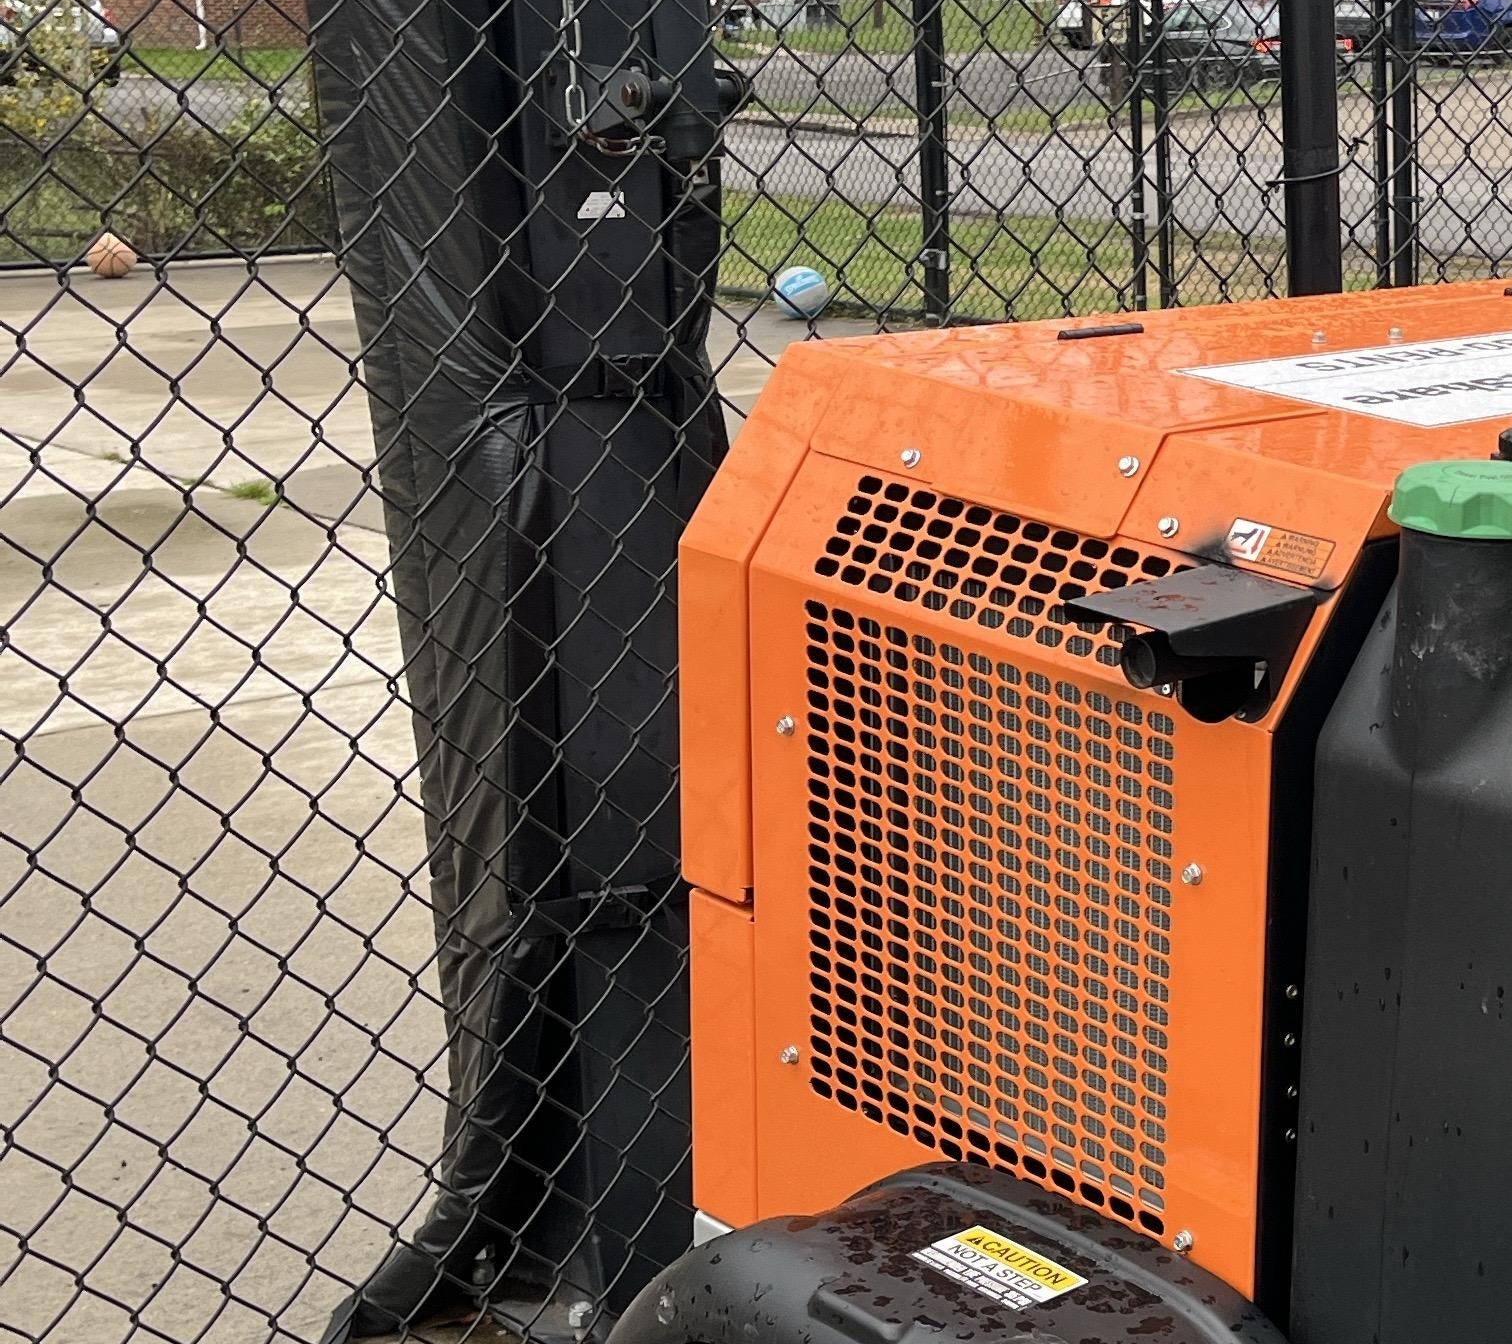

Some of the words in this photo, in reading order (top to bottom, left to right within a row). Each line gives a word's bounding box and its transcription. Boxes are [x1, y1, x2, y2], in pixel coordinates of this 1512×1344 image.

[949, 1244, 988, 1263] NOT
[981, 1262, 999, 1272] A
[997, 1268, 1042, 1291] STEP
[982, 1241, 1068, 1285] CAUTION
